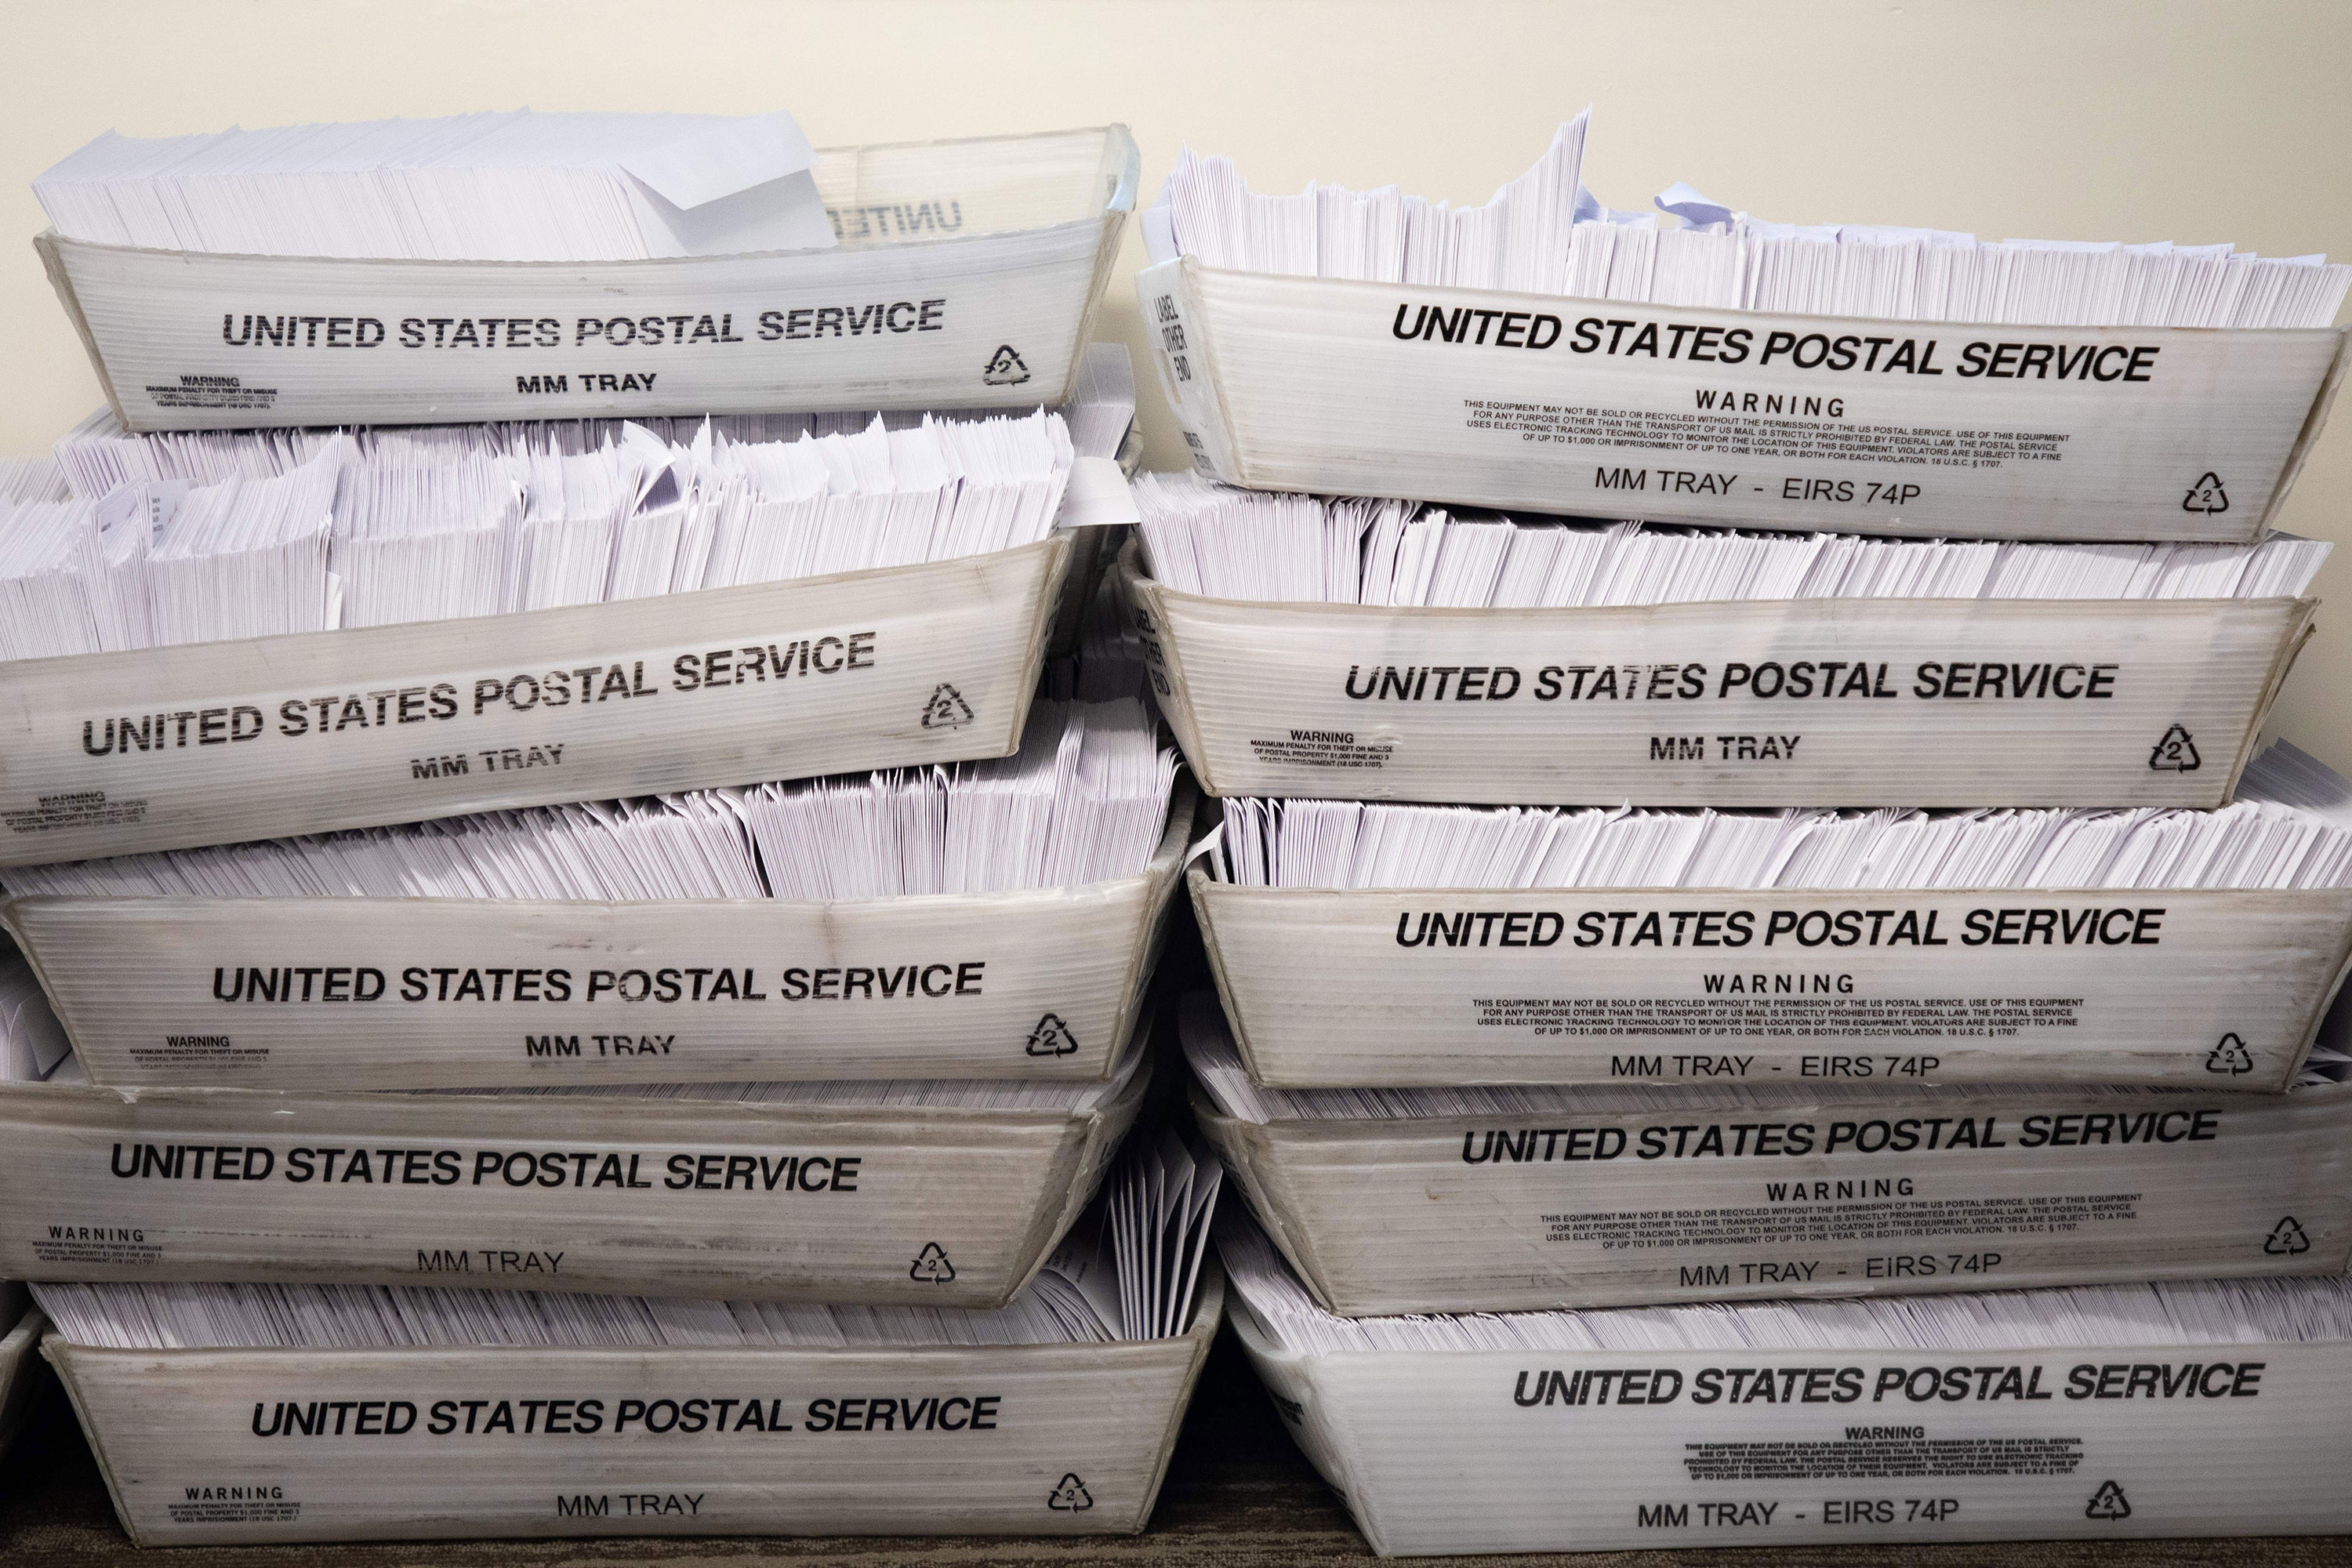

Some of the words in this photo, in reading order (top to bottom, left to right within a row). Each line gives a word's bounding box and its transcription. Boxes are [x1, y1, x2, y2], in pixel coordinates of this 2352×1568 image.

[1154, 294, 1178, 323] LABEL
[223, 314, 385, 347] UNITED
[398, 318, 561, 348] STATES
[575, 313, 744, 347] POSTAL
[757, 299, 946, 340] SERVICE
[1162, 324, 1188, 353] OTHER
[1392, 303, 1562, 350] UNITED
[1570, 317, 1754, 364] STATES
[1759, 331, 1944, 375] POSTAL
[1956, 342, 2161, 382] SERVICE
[180, 375, 240, 387] WARNING
[1174, 355, 1191, 382] END
[516, 375, 568, 394] MM
[578, 372, 657, 392] TRAY
[1696, 389, 1844, 418] WARNING
[1464, 399, 1484, 408] THIS
[1486, 401, 1541, 412] EQUIPMENT
[1542, 405, 1563, 413] MAY
[1564, 406, 1584, 415] NOT
[1586, 408, 1599, 416] BE
[1601, 408, 1627, 418] SOLD
[1628, 410, 1642, 419] OR
[1645, 412, 1695, 423] RECYCLED
[1697, 415, 1740, 425] WITHOUT
[1762, 419, 1820, 430] PERMISSION
[1873, 426, 1910, 434] POSTAL
[1911, 428, 1955, 437] SERVICE.
[1993, 431, 2013, 440] THIS
[2016, 432, 2071, 441] EQUIPMENT
[1595, 466, 1646, 490] MM
[1657, 470, 1737, 495] TRAY
[1782, 477, 1854, 502] EIRS
[1866, 482, 1921, 505] 74P
[82, 706, 263, 757] UNITED
[278, 683, 458, 737] STATES
[474, 661, 659, 716] POSTAL
[672, 631, 877, 692] SERVICE
[1345, 665, 1521, 702] UNITED
[1534, 662, 1707, 701] STATES
[1718, 661, 1897, 699] POSTAL
[1913, 661, 2119, 699] SERVICE
[937, 700, 953, 718] 2
[1250, 739, 1284, 748] MAXIMUM
[1332, 742, 1354, 752] THEFT
[1290, 730, 1354, 743] WARNING
[1650, 736, 1704, 760] MM
[1716, 735, 1801, 760] TRAY
[410, 753, 469, 779] MM
[478, 744, 564, 771] TRAY
[1265, 748, 1291, 757] POSTAL
[2167, 742, 2182, 760] 2
[39, 791, 106, 807] WARNING
[1396, 912, 1564, 947] UNITED
[1573, 910, 1755, 948] STATES
[1764, 909, 1948, 947] POSTAL
[1961, 908, 2166, 946] SERVICE
[212, 967, 386, 1002] UNITED
[400, 967, 572, 1003] STATES
[586, 967, 767, 1004] POSTAL
[781, 961, 985, 1002] SERVICE
[1703, 974, 1853, 993] WARNING
[166, 1036, 230, 1047] WARNING
[524, 1035, 581, 1057] MM
[591, 1035, 675, 1056] TRAY
[1042, 1029, 1058, 1046] 2
[1611, 1055, 1662, 1076] MM
[1671, 1055, 1755, 1076] TRAY
[1800, 1055, 1872, 1077] EIRS
[1884, 1056, 1940, 1076] 74P
[1461, 1127, 1627, 1165] UNITED
[1635, 1123, 1815, 1160] STATES
[1824, 1116, 2006, 1154] POSTAL
[2018, 1109, 2223, 1148] SERVICE
[111, 1143, 274, 1181] UNITED
[285, 1147, 462, 1185] STATES
[472, 1150, 652, 1189] POSTAL
[663, 1153, 862, 1192] SERVICE
[1766, 1178, 1913, 1202] WARNING
[48, 1225, 143, 1243] WARNING
[416, 1250, 470, 1272] MM
[479, 1250, 564, 1274] TRAY
[1679, 1265, 1730, 1287] MM
[1739, 1261, 1820, 1283] TRAY
[1866, 1254, 1936, 1278] EIRS
[1947, 1253, 2002, 1274] 74P
[1513, 1368, 1683, 1407] UNITED
[1691, 1367, 1865, 1405] STATES
[1872, 1366, 2053, 1403] POSTAL
[2063, 1362, 2266, 1400] SERVICE
[252, 1400, 417, 1437] UNITED
[426, 1399, 604, 1436] STATES
[614, 1399, 793, 1434] POSTAL
[804, 1396, 1001, 1432] SERVICE
[1845, 1425, 1925, 1439] WARNING
[185, 1486, 282, 1501] WARNING
[557, 1494, 609, 1517] MM
[619, 1494, 705, 1516] TRAY
[1638, 1503, 1689, 1527] MM
[1697, 1501, 1779, 1527] TRAY
[1824, 1500, 1894, 1524] EIRS
[1904, 1497, 1959, 1523] 74P
